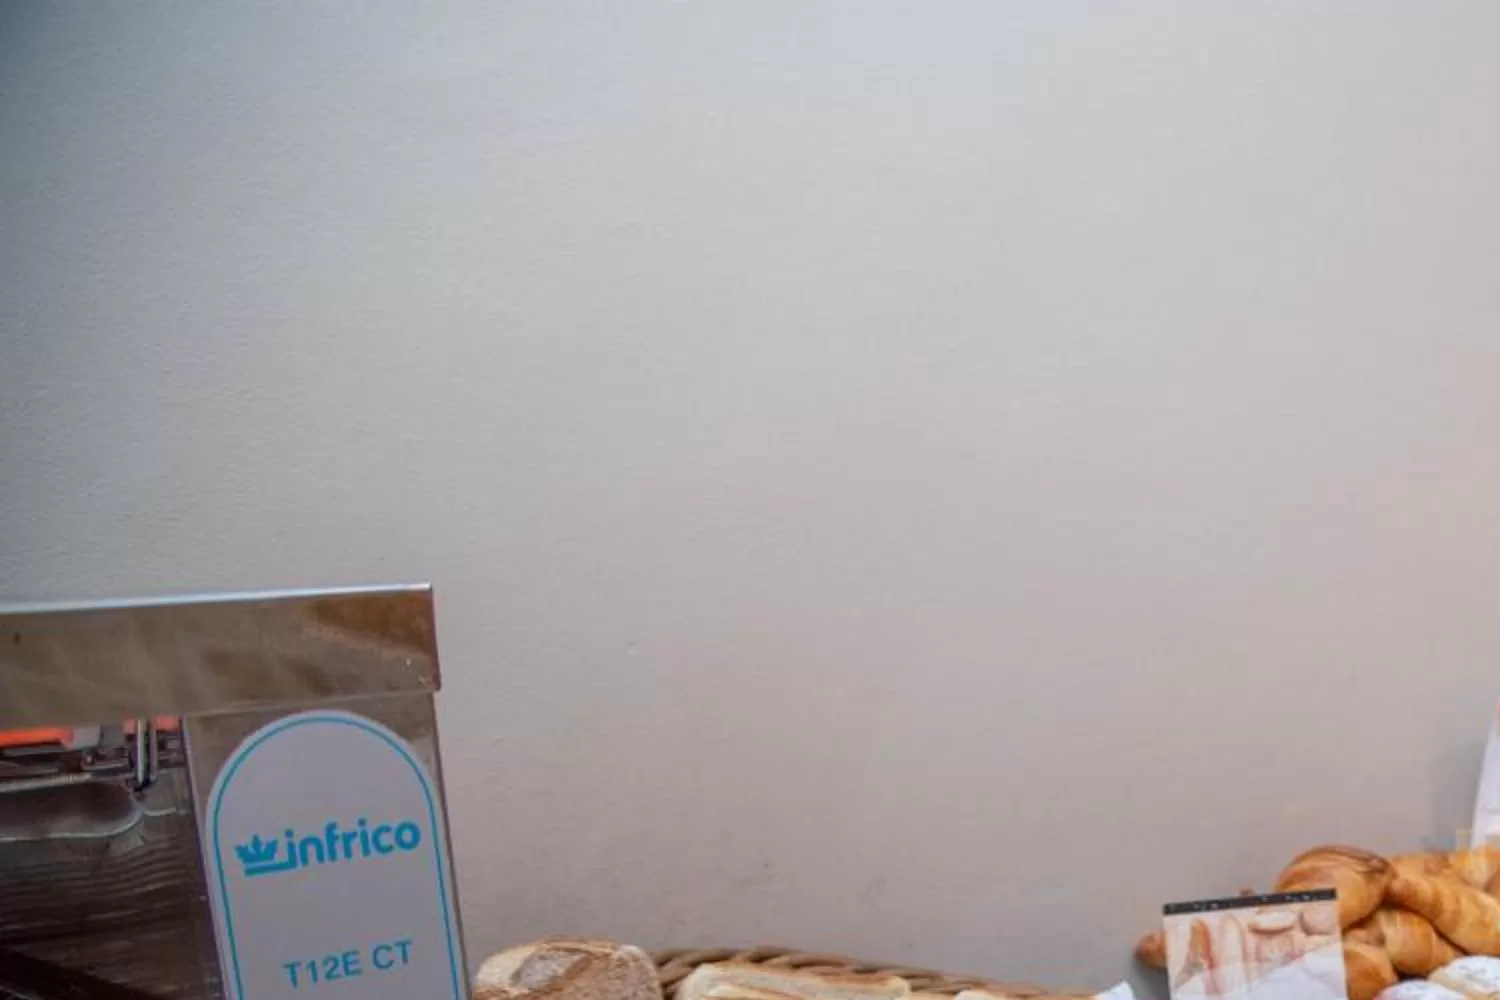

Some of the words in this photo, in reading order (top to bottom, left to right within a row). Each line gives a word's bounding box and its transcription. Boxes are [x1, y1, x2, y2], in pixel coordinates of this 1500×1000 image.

[284, 818, 422, 868] infrico
[283, 951, 363, 988] T12E
[372, 940, 412, 970] CT
